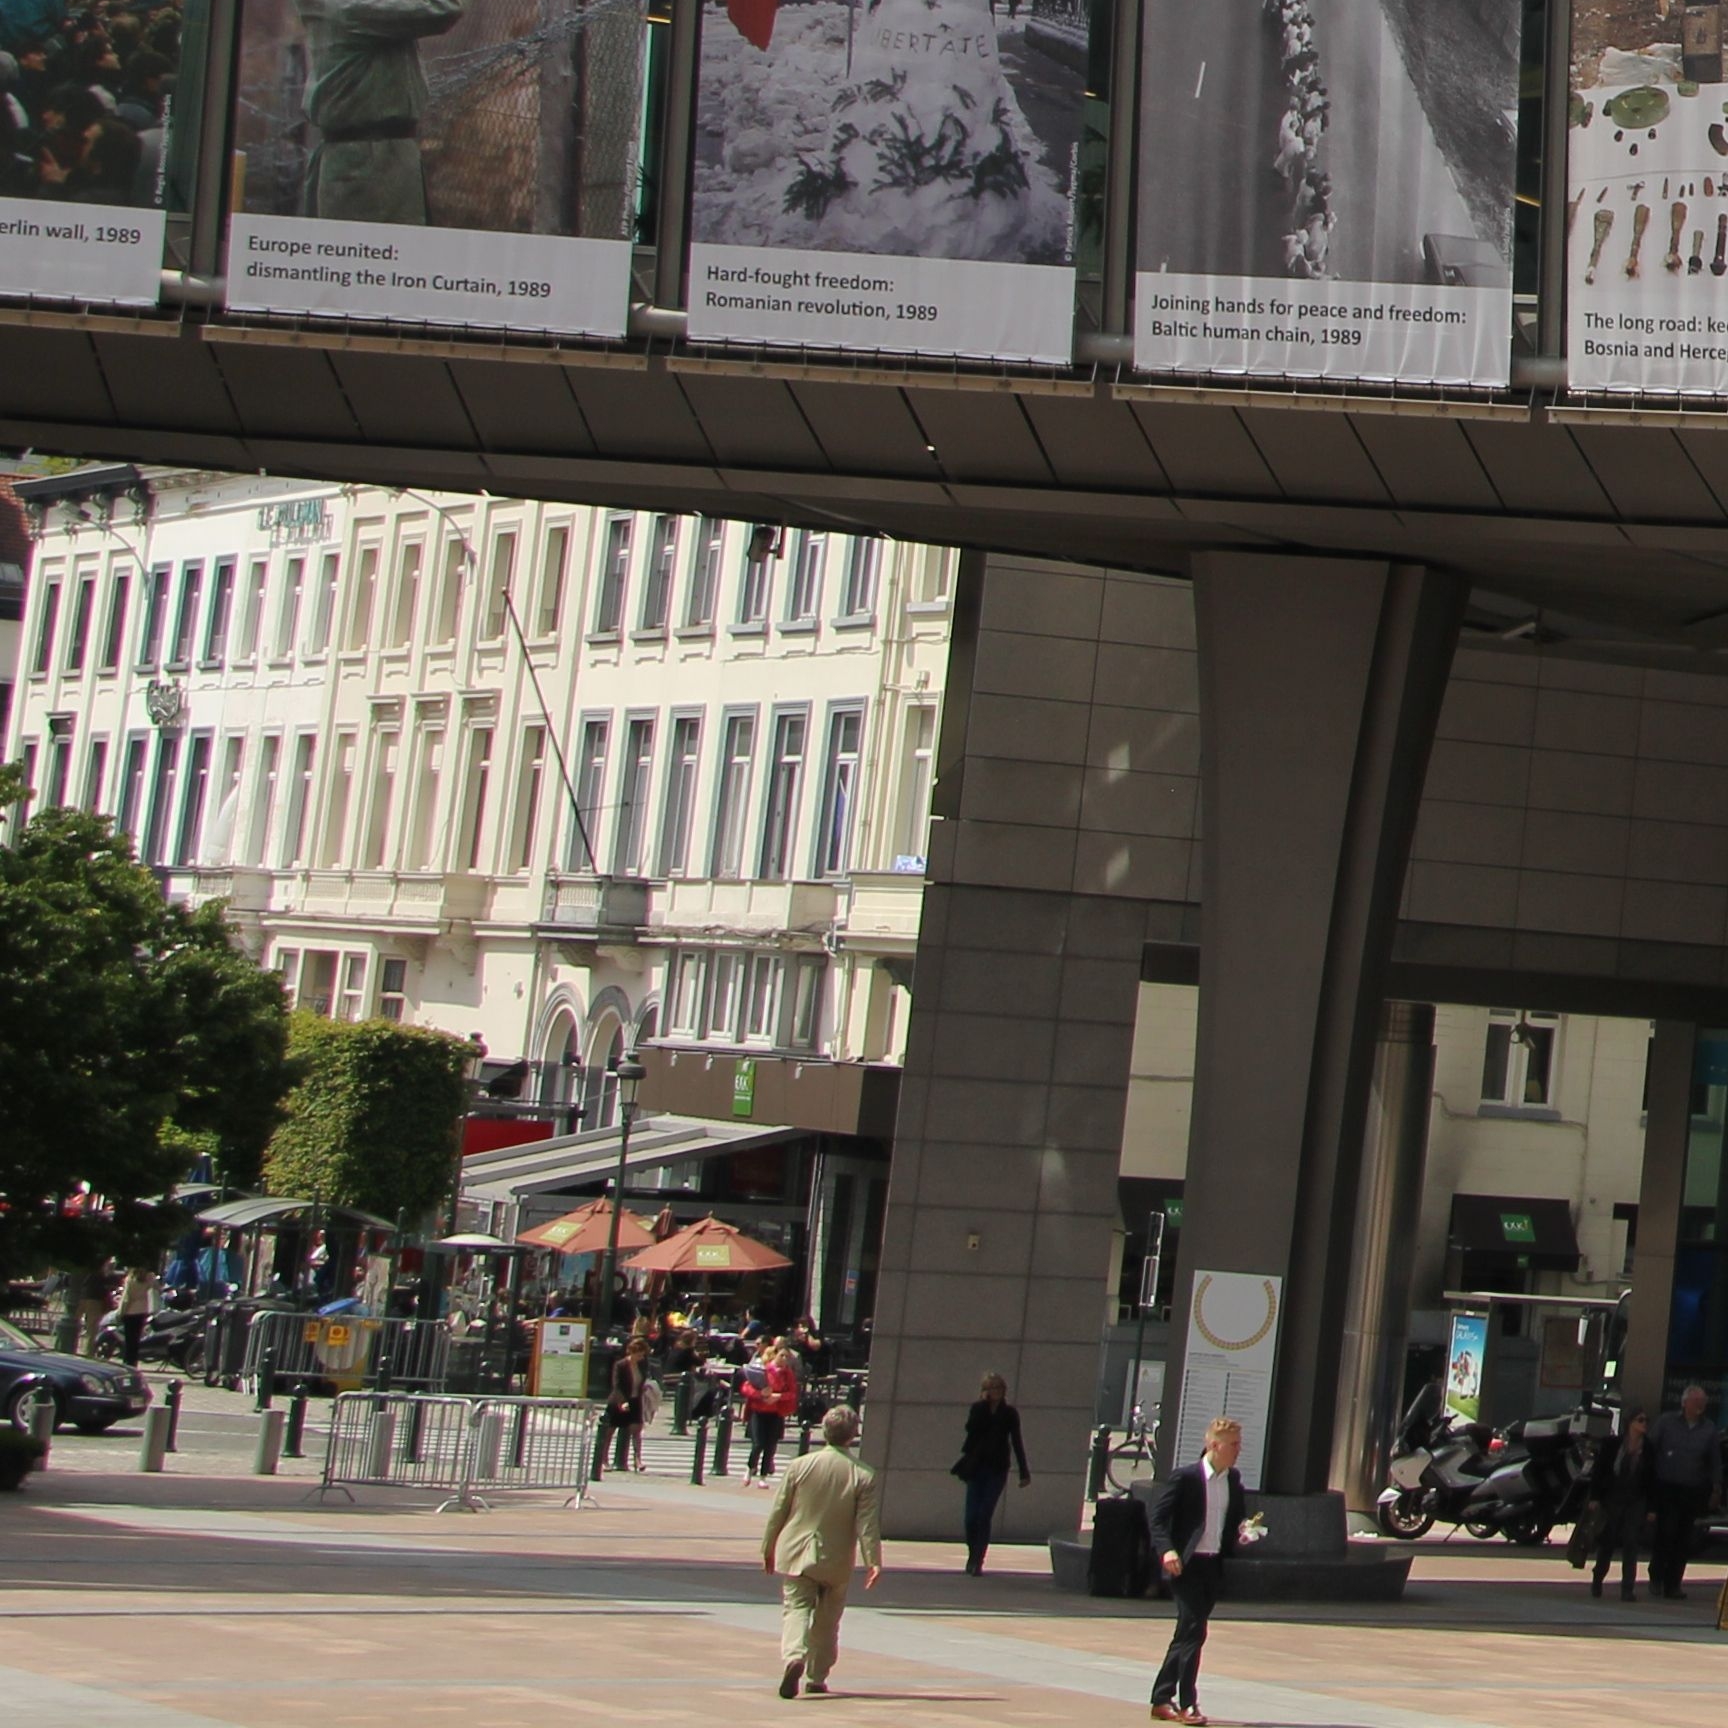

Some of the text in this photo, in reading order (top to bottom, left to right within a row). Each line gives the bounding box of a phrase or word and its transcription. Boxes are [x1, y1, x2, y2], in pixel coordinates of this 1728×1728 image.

[46, 224, 88, 242] wall,
[96, 227, 140, 244] 1989
[1065, 226, 1074, 253] Patrick
[249, 236, 398, 260] Europe reunited:
[247, 262, 550, 297] dismantling the Iron Curtain, 1989
[708, 266, 893, 292] Hard-fought freedom:
[706, 292, 937, 321] Romanian revolution, 1989
[1152, 295, 1466, 323] Joining hands for peace and freedom:
[1152, 321, 1361, 346] Baltic human chain, 1989
[1584, 313, 1614, 329] The
[1619, 313, 1654, 334] long
[1659, 316, 1701, 332] road:
[1585, 340, 1638, 357] Bosnia
[1644, 342, 1674, 358] and
